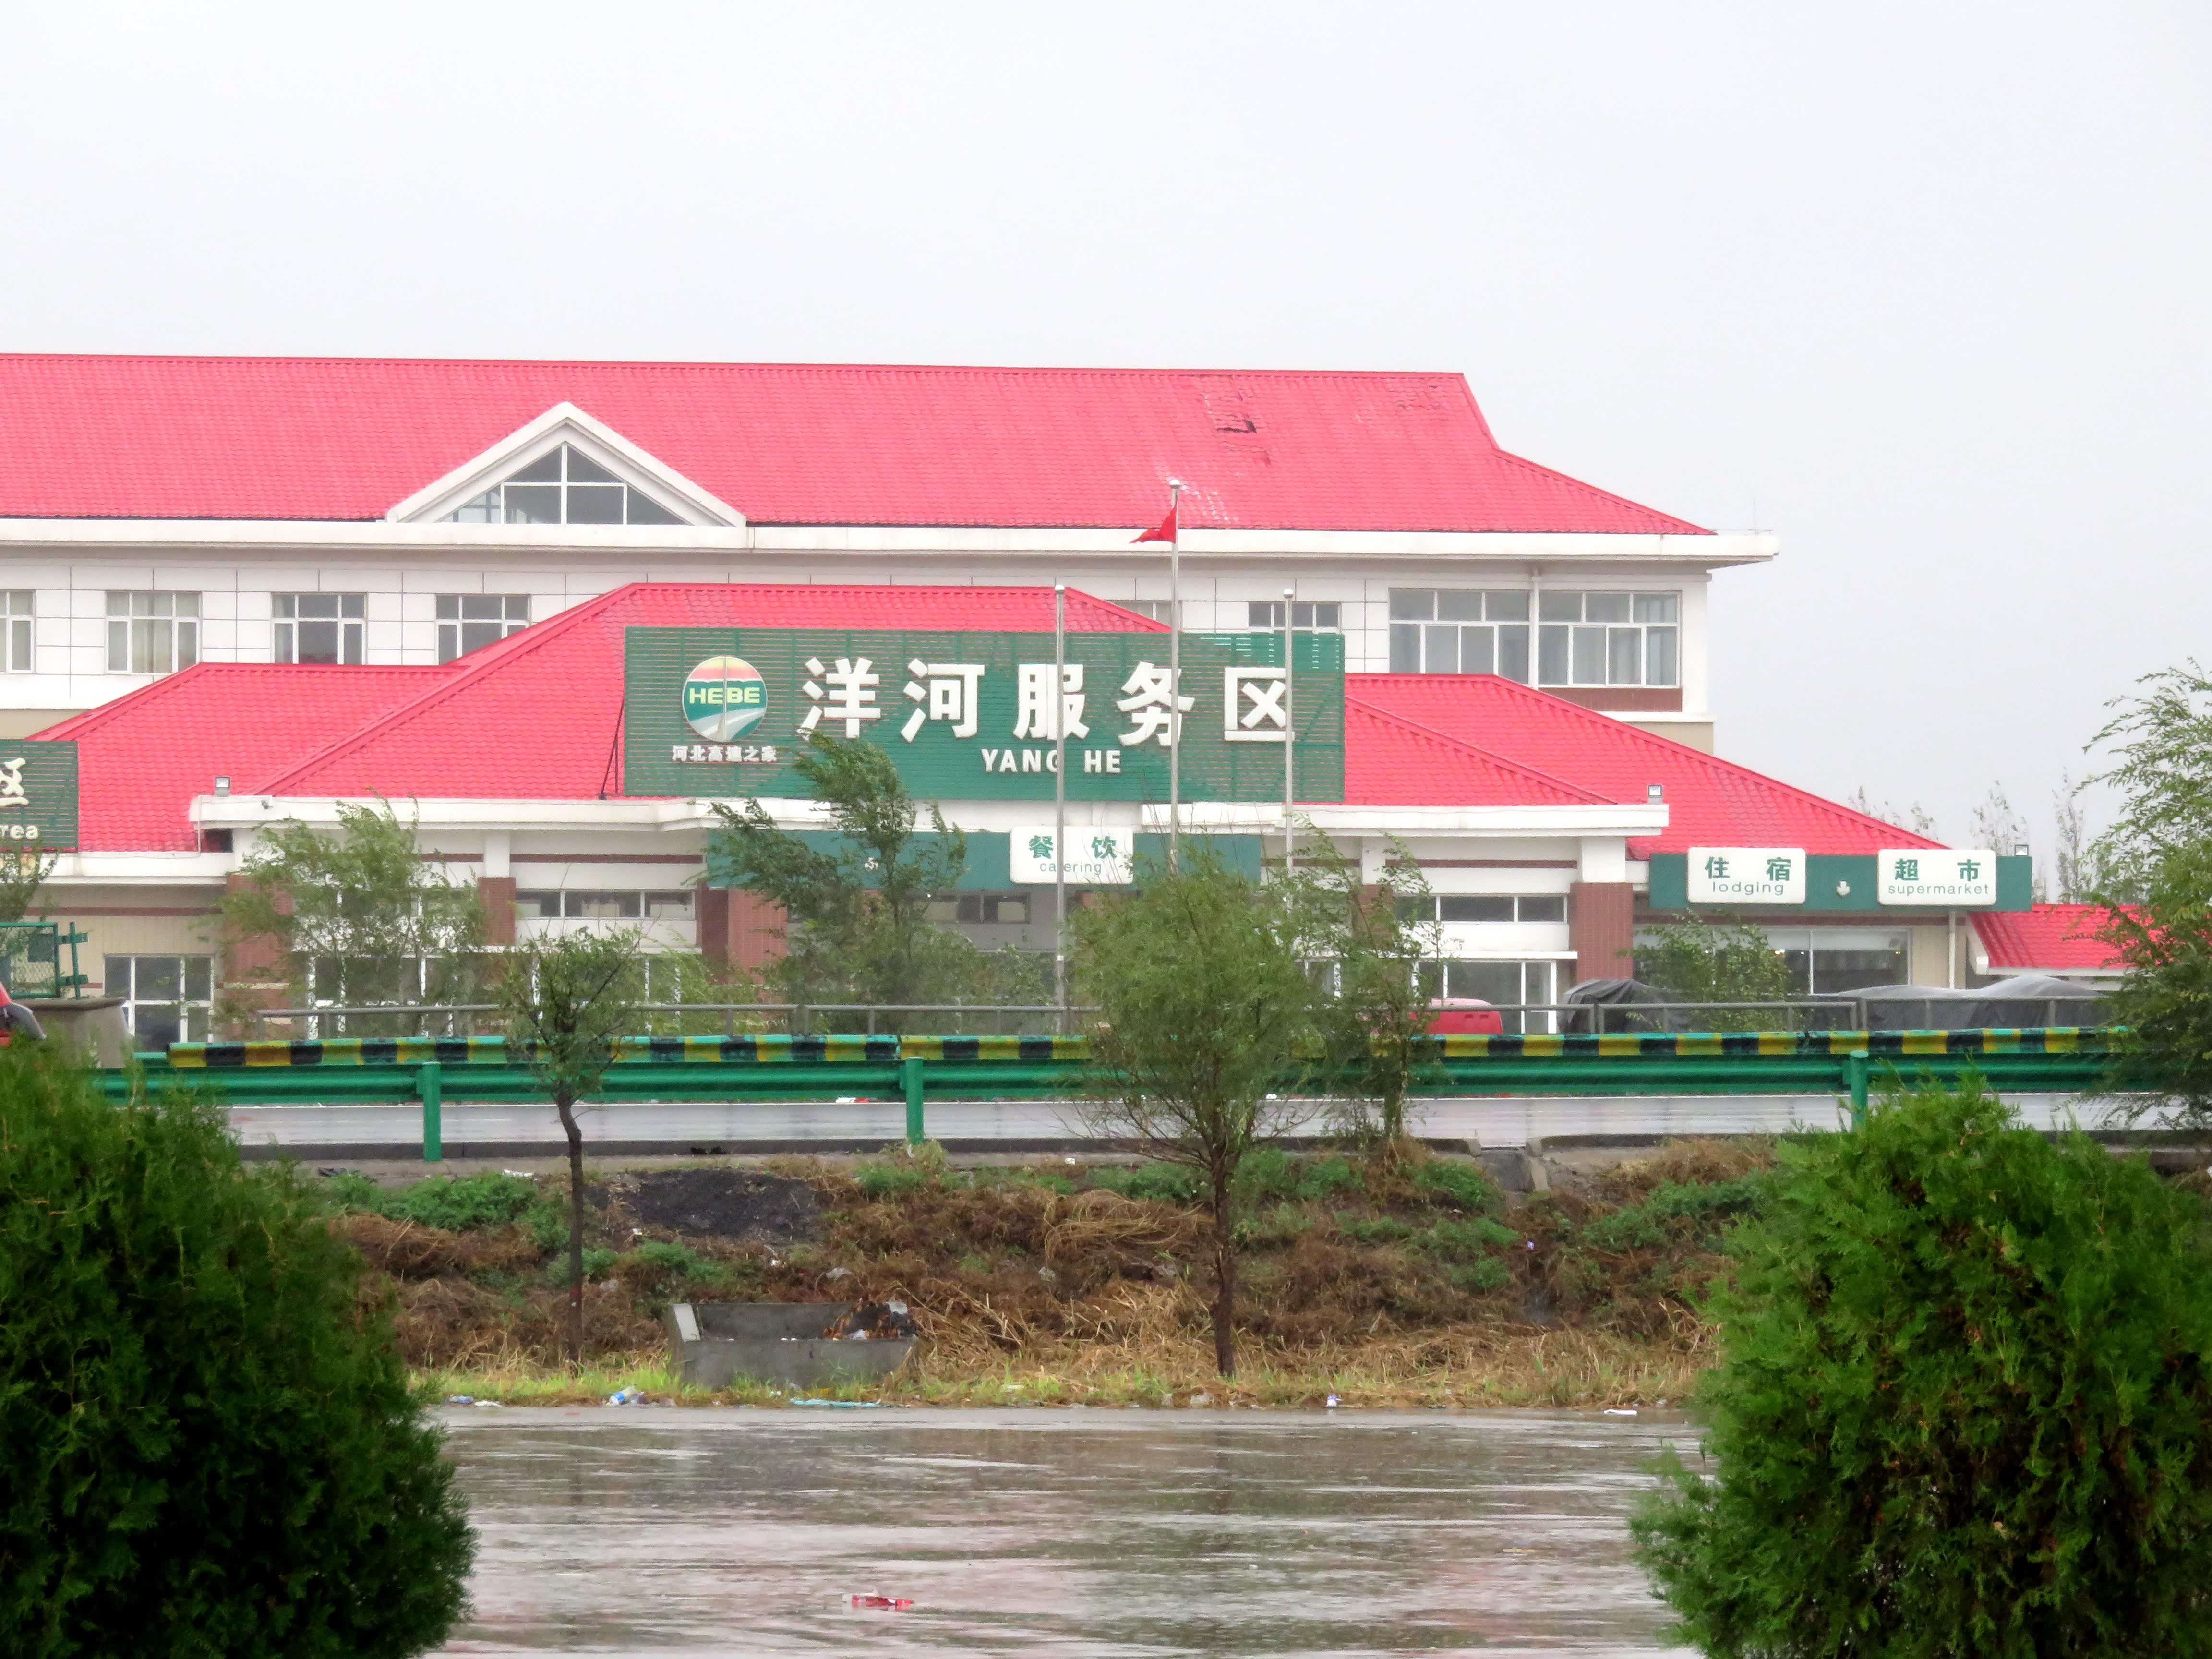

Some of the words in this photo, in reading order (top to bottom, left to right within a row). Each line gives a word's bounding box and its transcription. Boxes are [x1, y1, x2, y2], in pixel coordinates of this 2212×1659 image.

[689, 687, 760, 704] HEBE
[796, 656, 1295, 746] 洋河服务区
[1084, 750, 1121, 773] HE
[1028, 835, 1118, 860] 餐饮
[1040, 862, 1102, 875] caering
[1705, 856, 1791, 881] 住宿
[1894, 858, 1981, 881] 超市
[1712, 881, 1784, 896] lodging
[1888, 884, 1989, 896] supermarket
